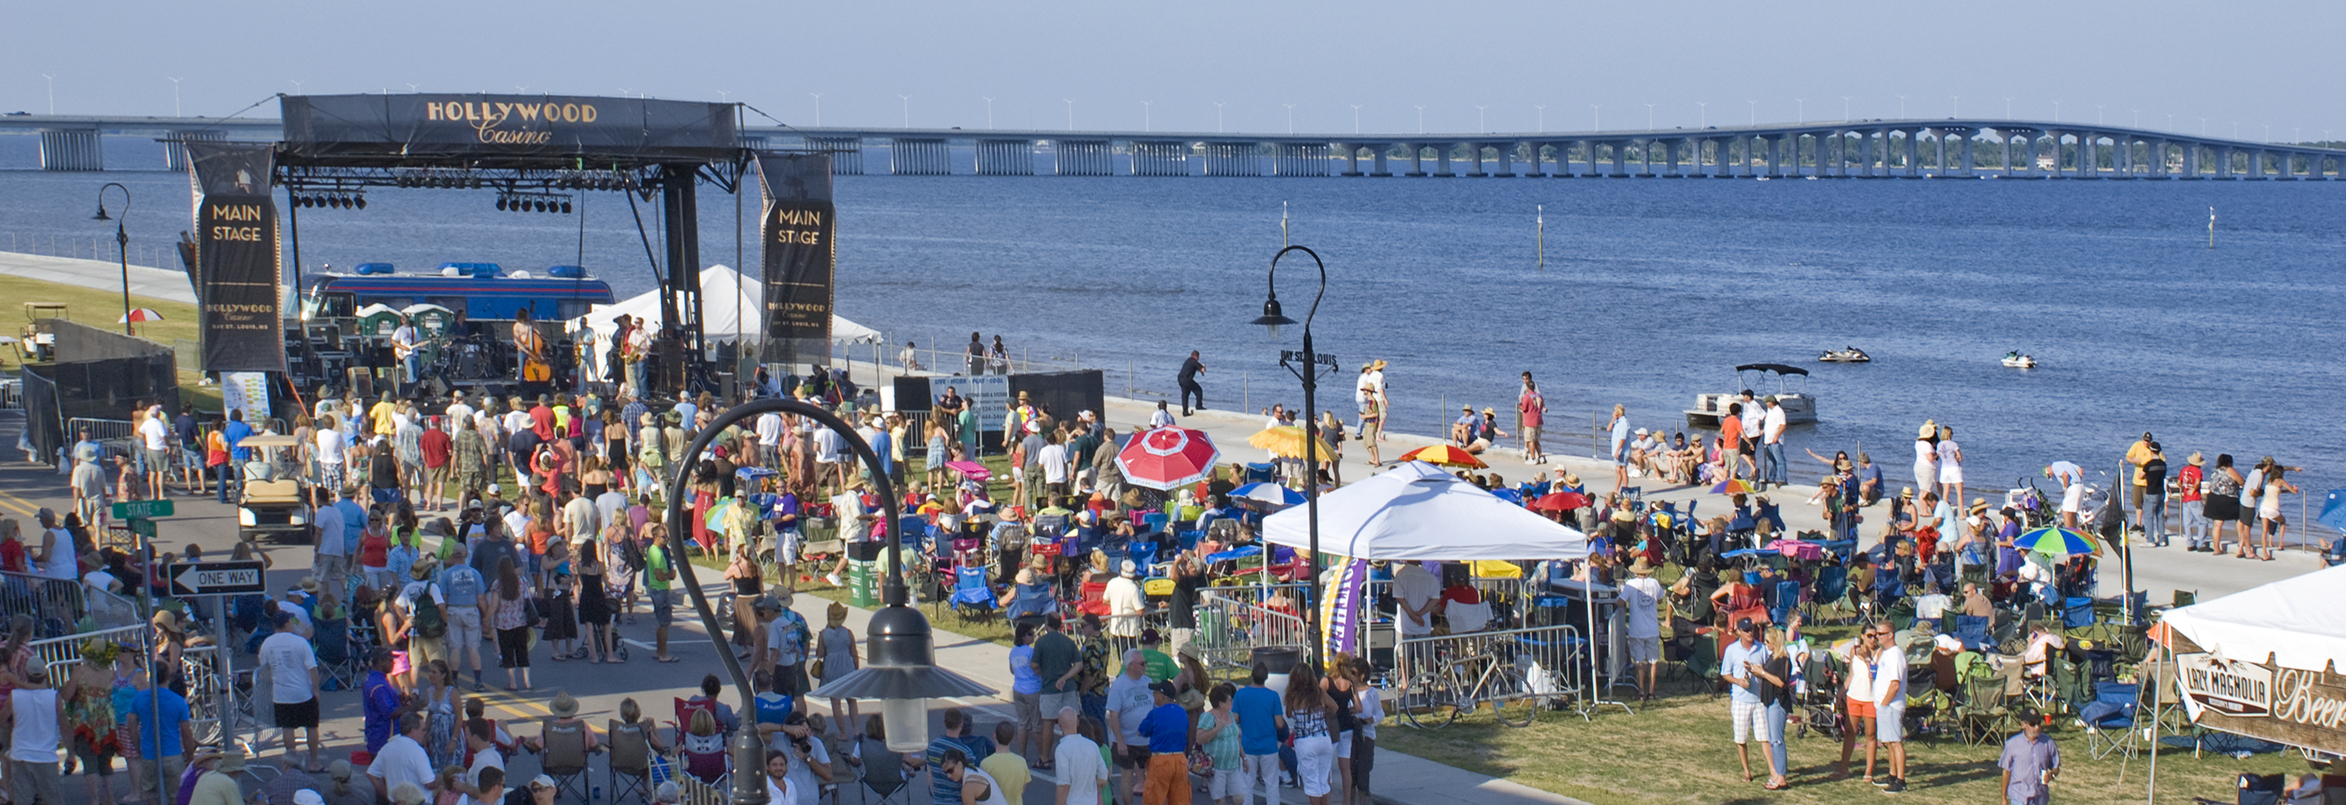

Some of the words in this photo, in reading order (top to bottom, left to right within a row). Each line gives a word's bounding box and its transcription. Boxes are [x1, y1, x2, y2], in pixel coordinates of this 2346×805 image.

[427, 102, 597, 123] HOLLYWOOD
[470, 113, 552, 143] Casino
[213, 204, 261, 221] MAIN
[779, 208, 820, 226] MAIN
[213, 226, 261, 241] STAGE
[778, 230, 819, 245] STAGE
[206, 304, 273, 313] HOLLYWOOD
[768, 302, 825, 312] HOLLYWOOD
[126, 502, 153, 516] STATE
[199, 572, 225, 585] ONE
[229, 571, 254, 583] WAY
[2186, 667, 2208, 692] LAZY
[2211, 671, 2266, 705] MAGNOLIA
[2274, 668, 2346, 728] Beer
